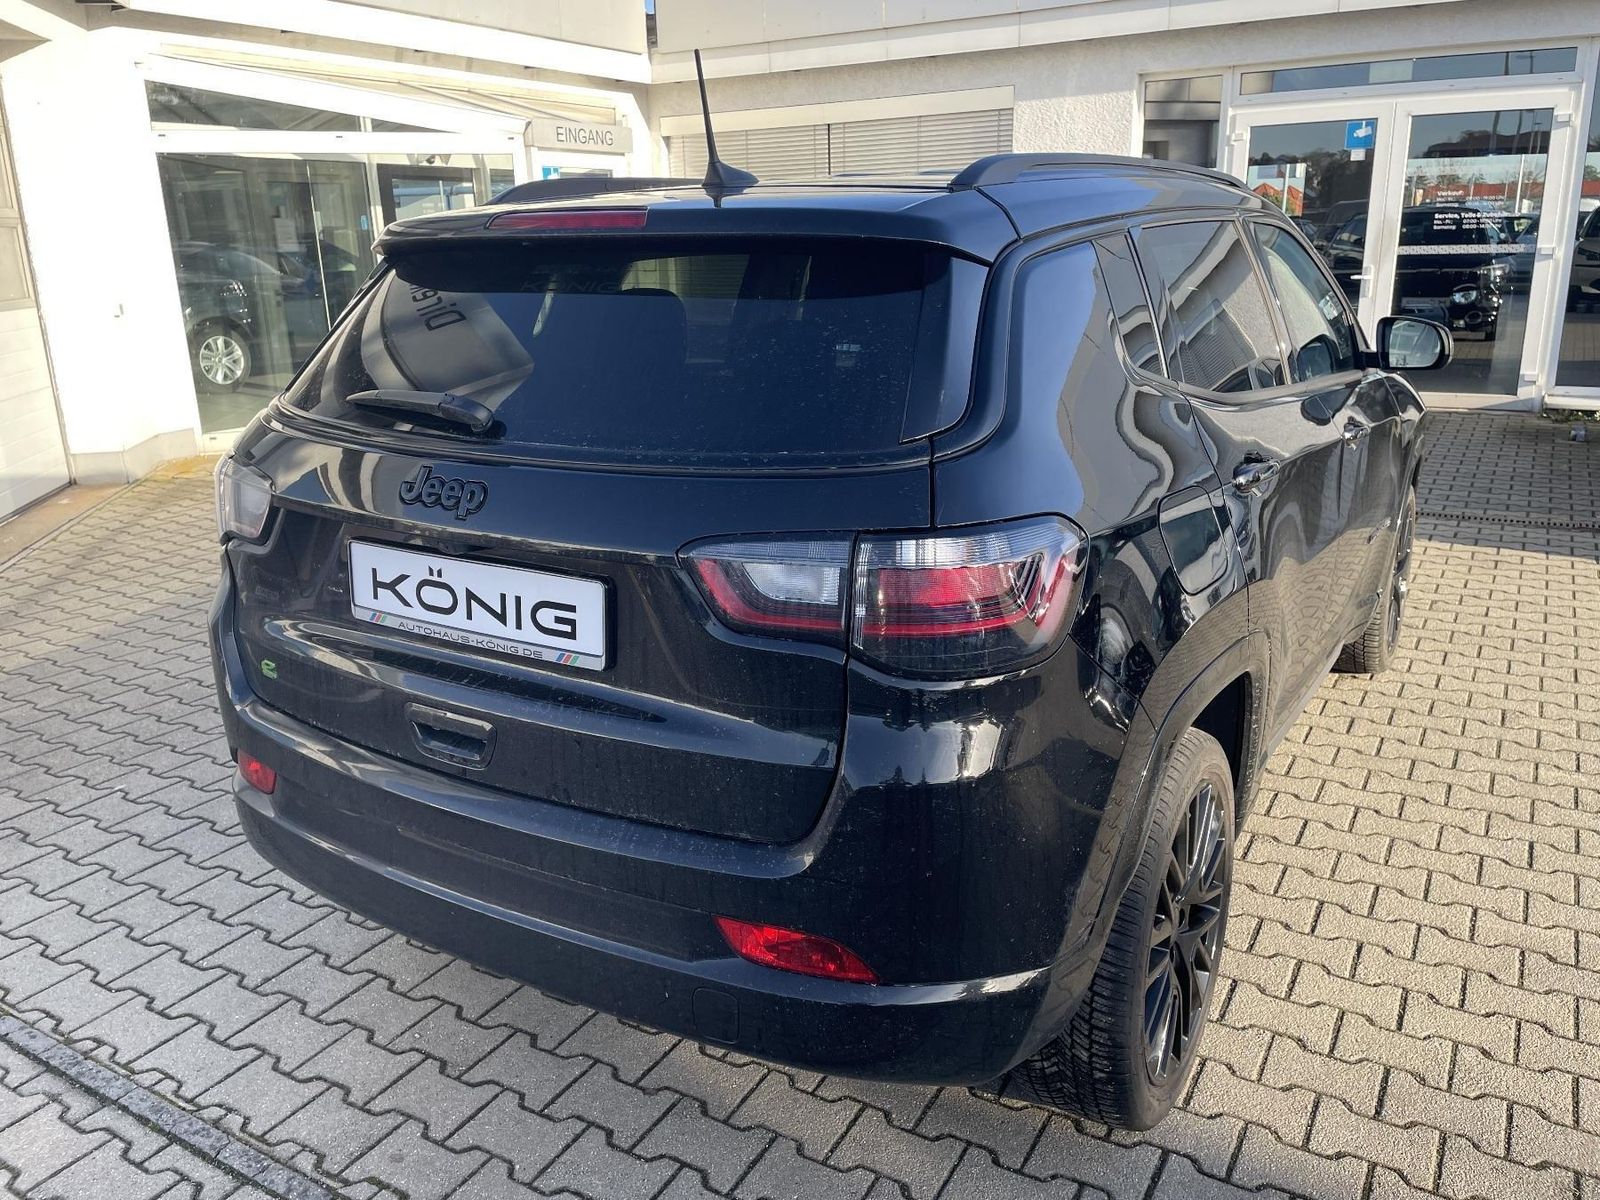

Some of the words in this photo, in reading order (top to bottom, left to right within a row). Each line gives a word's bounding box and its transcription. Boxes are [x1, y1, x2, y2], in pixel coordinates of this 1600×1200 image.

[556, 126, 614, 146] EINGANG
[400, 464, 488, 521] Jeep
[371, 565, 577, 641] KÖNIG
[397, 620, 544, 660] AUTOHAUS-KÖNIG.DE
